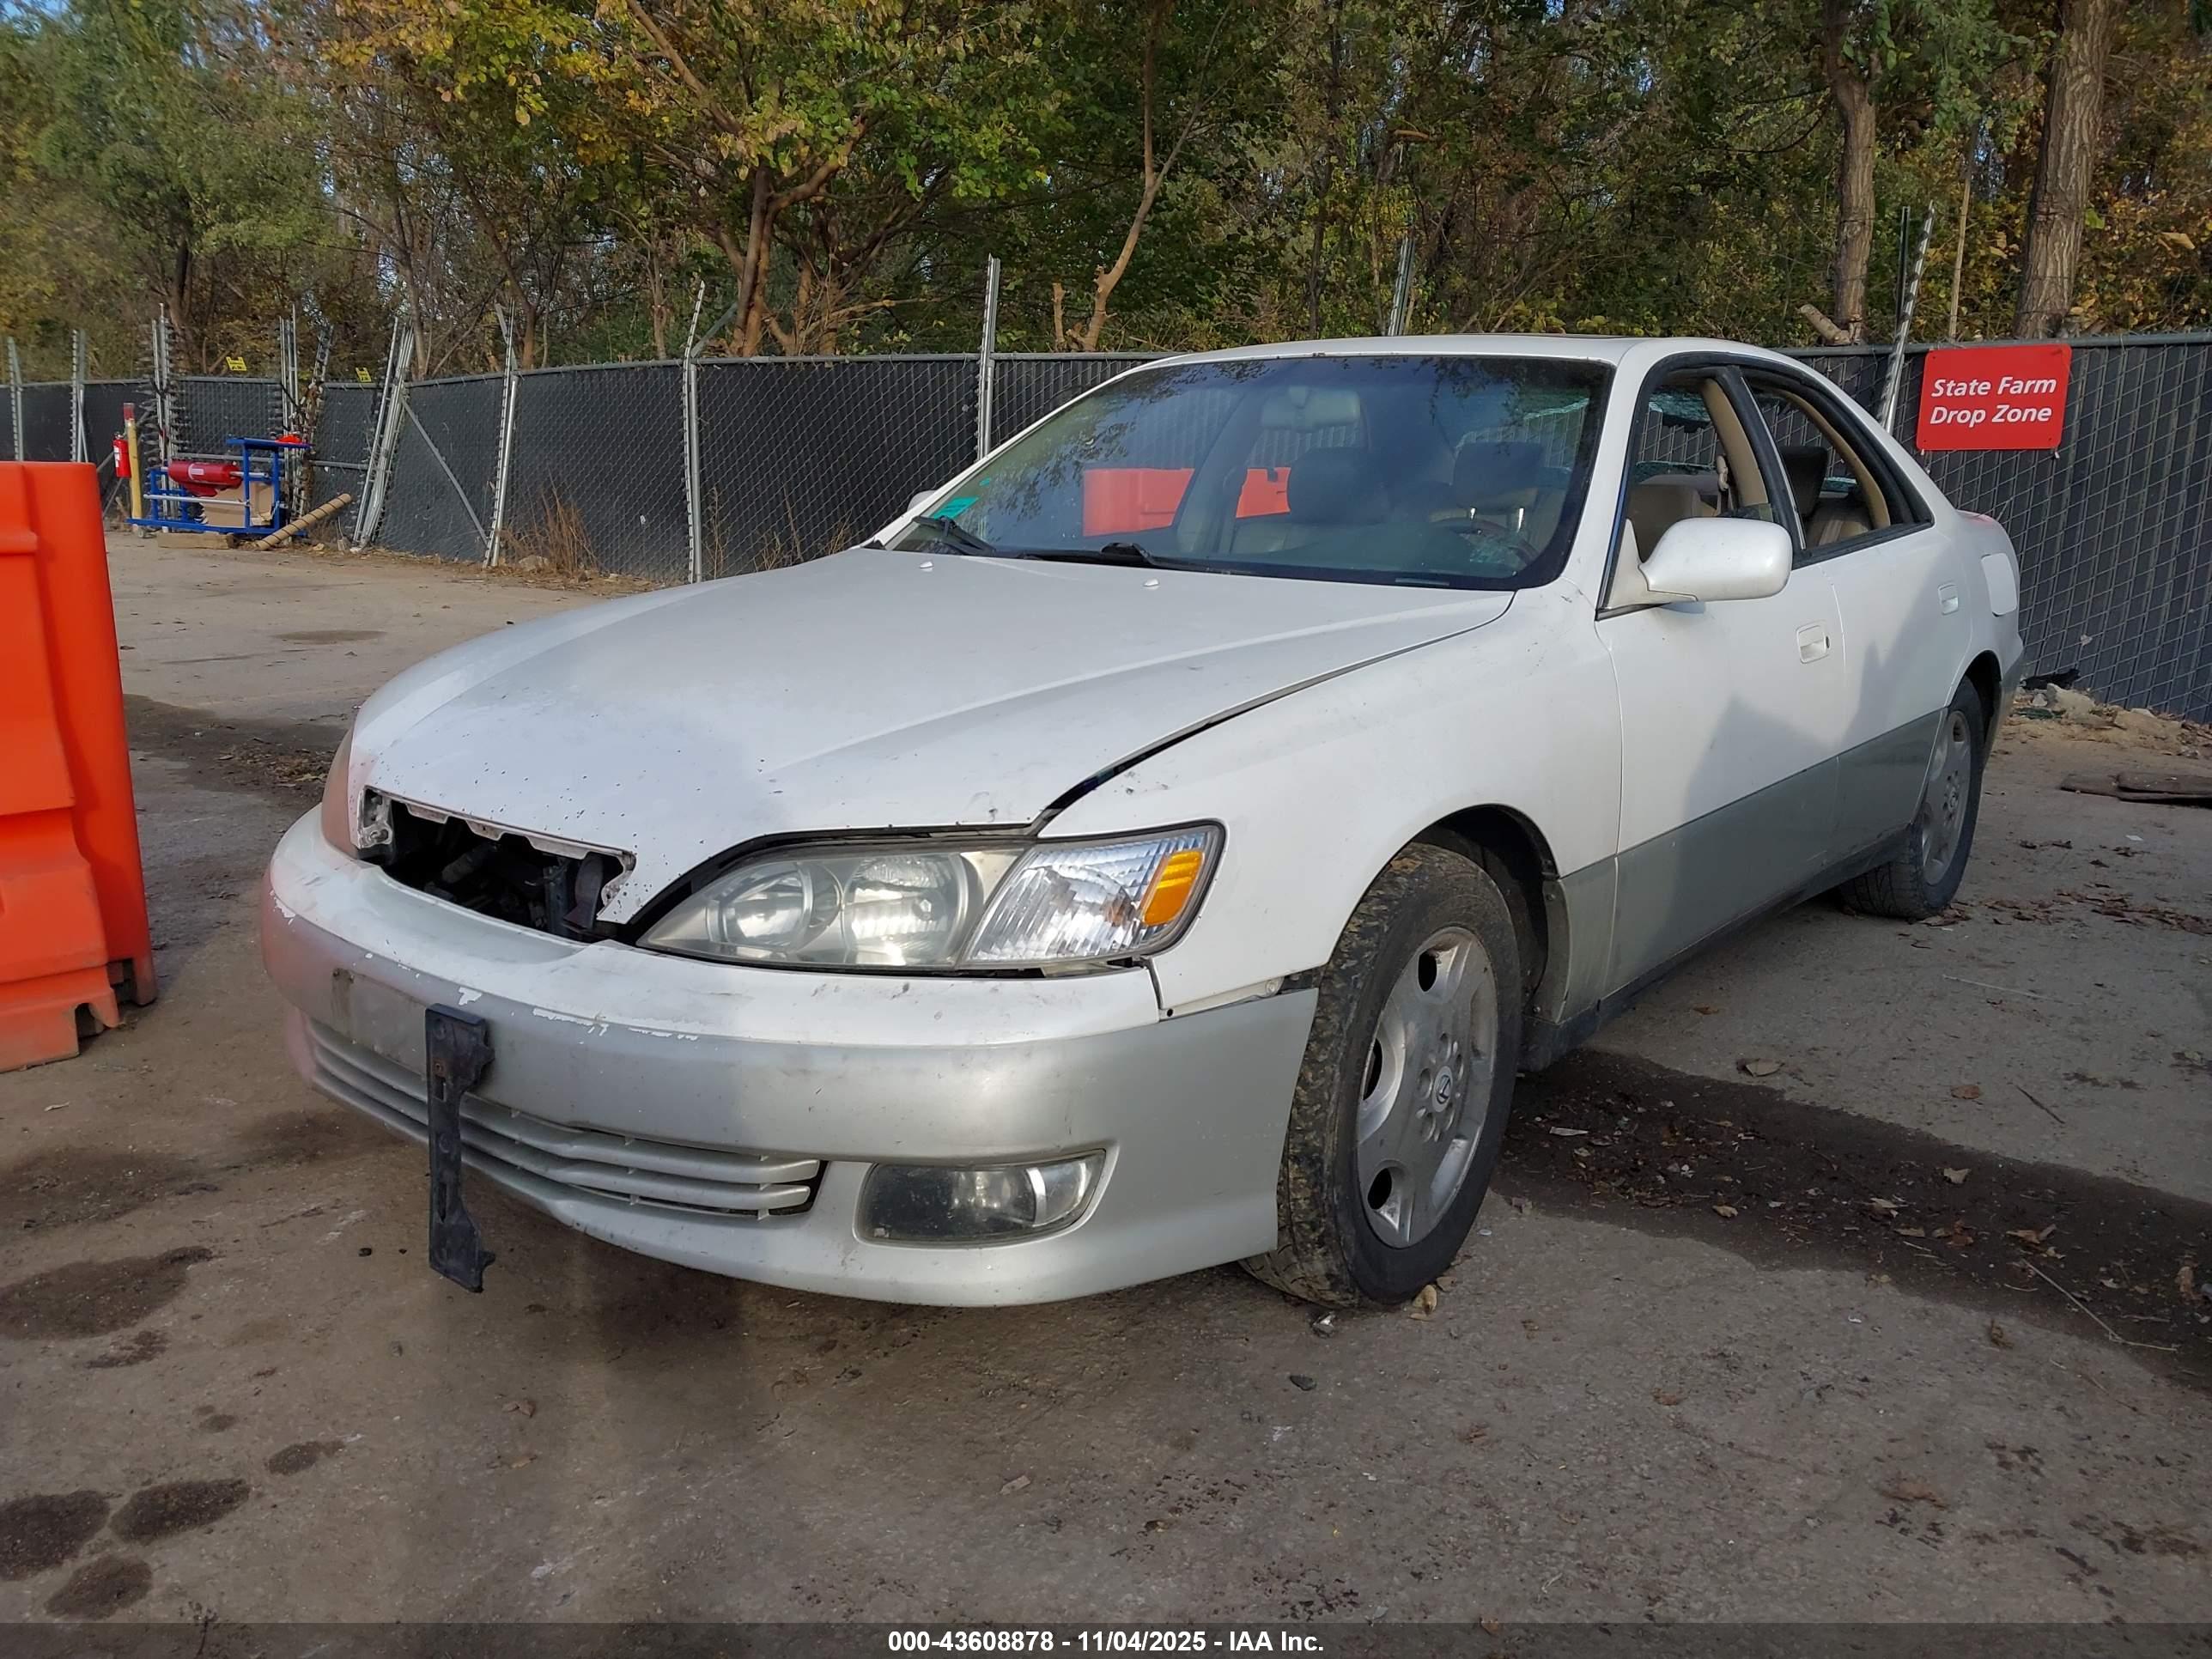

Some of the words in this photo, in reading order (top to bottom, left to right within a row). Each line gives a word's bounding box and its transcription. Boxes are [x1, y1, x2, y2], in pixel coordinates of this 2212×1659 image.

[1930, 379, 1991, 398] State
[1997, 376, 2057, 395] Farm
[1929, 406, 1986, 428] Drop
[1991, 404, 2052, 423] Zone
